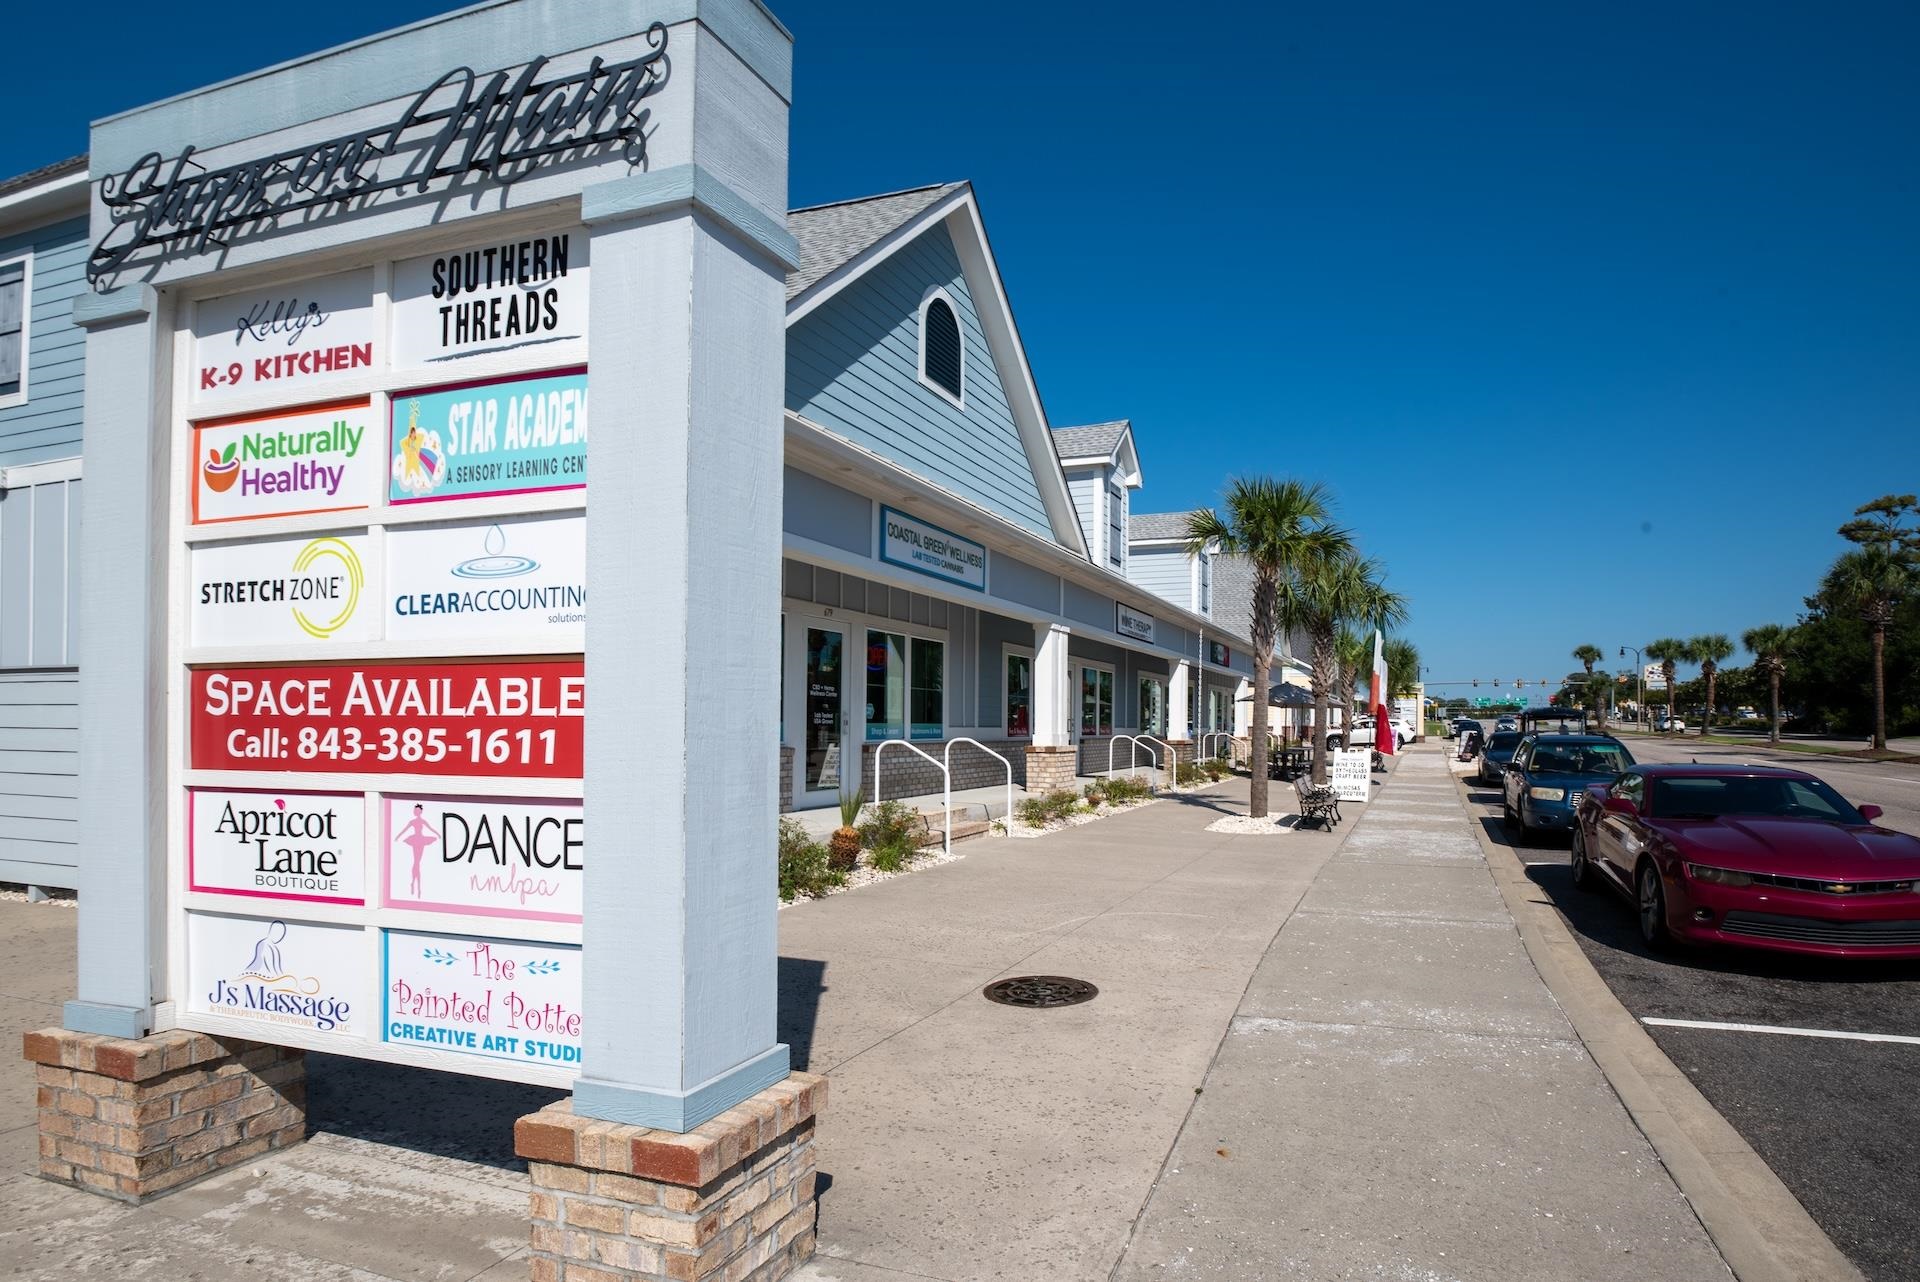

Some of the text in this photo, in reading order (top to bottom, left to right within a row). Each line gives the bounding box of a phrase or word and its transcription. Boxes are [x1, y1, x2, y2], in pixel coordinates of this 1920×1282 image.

[86, 54, 656, 285] Shops on Main
[431, 234, 569, 299] SOUTHERN
[235, 298, 330, 347] Kelly's
[439, 287, 558, 347] THREADS
[201, 342, 373, 390] K-9 KITCHEN
[242, 420, 365, 458] Naturally
[447, 398, 498, 457] STAR
[241, 460, 345, 497] Healthy
[446, 455, 588, 485] A SENSORY LEARNING CEN
[887, 522, 983, 569] COASTAL GREEN WELLNESS
[912, 549, 965, 575] LAB TESTED CANNABIS
[201, 579, 285, 605] STRETCH
[204, 671, 585, 719] SPACE AVAILABLE
[226, 726, 556, 765] Call: 843-385-1611
[214, 798, 338, 844] Apricot
[442, 811, 584, 871] DANCE
[255, 838, 338, 877] Lane
[255, 874, 339, 892] BOUTIQUE
[466, 941, 516, 981] The
[208, 979, 350, 1031] J's Massage
[391, 978, 583, 1037] Painted Potte
[390, 1022, 477, 1048] CREATIVE
[482, 1034, 519, 1054] ART
